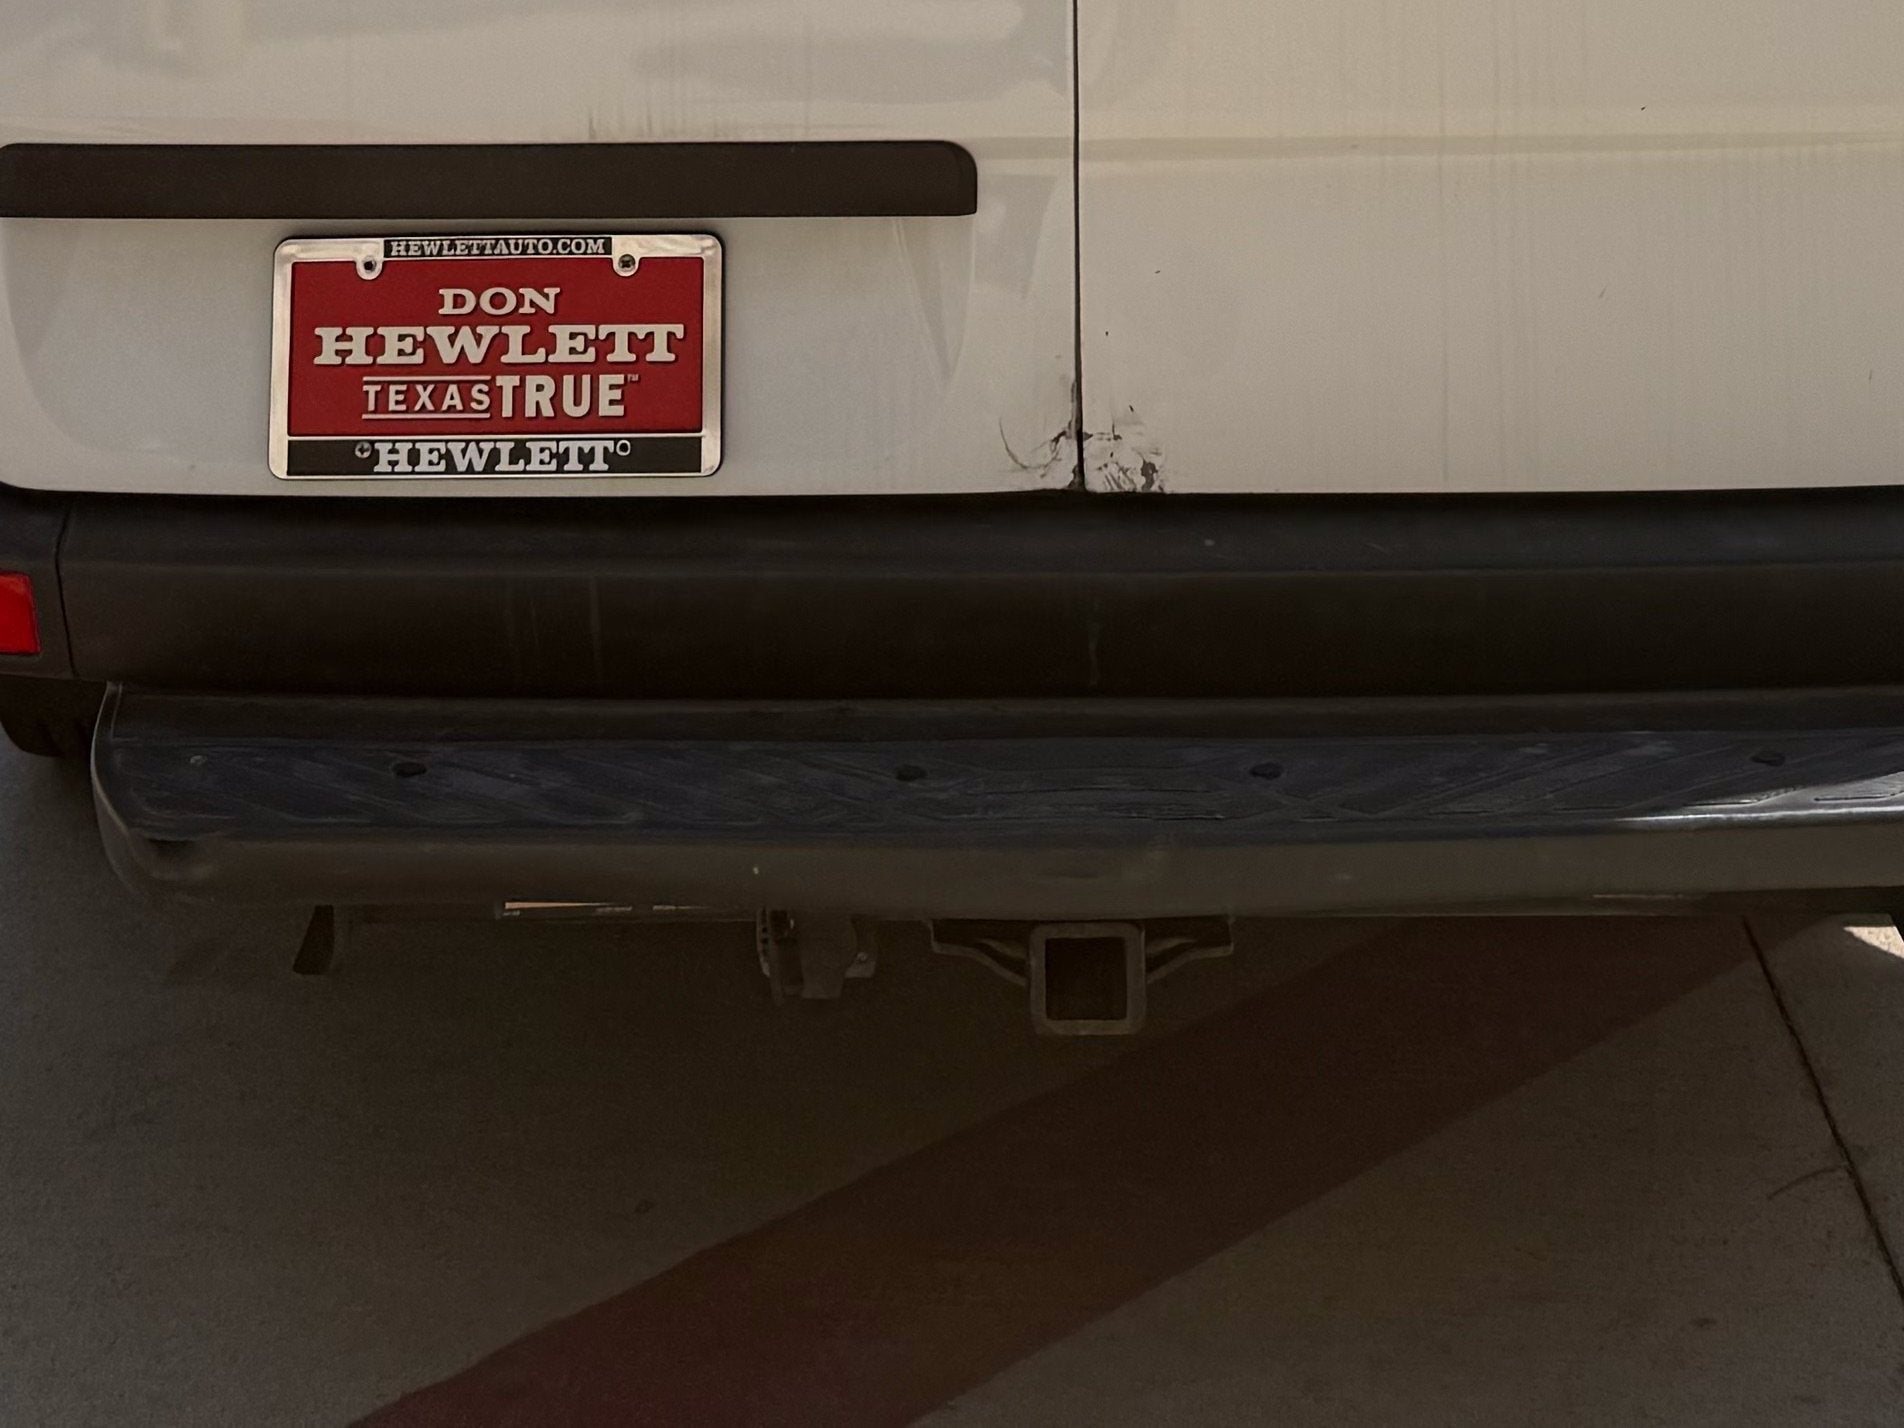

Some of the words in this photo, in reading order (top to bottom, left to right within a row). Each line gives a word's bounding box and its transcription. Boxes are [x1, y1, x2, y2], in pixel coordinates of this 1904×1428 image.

[389, 237, 606, 256] HEWLETTAUTO.COM
[438, 286, 561, 315] DON
[313, 323, 684, 365] HEWLETT
[373, 440, 615, 473] HEWLETT
